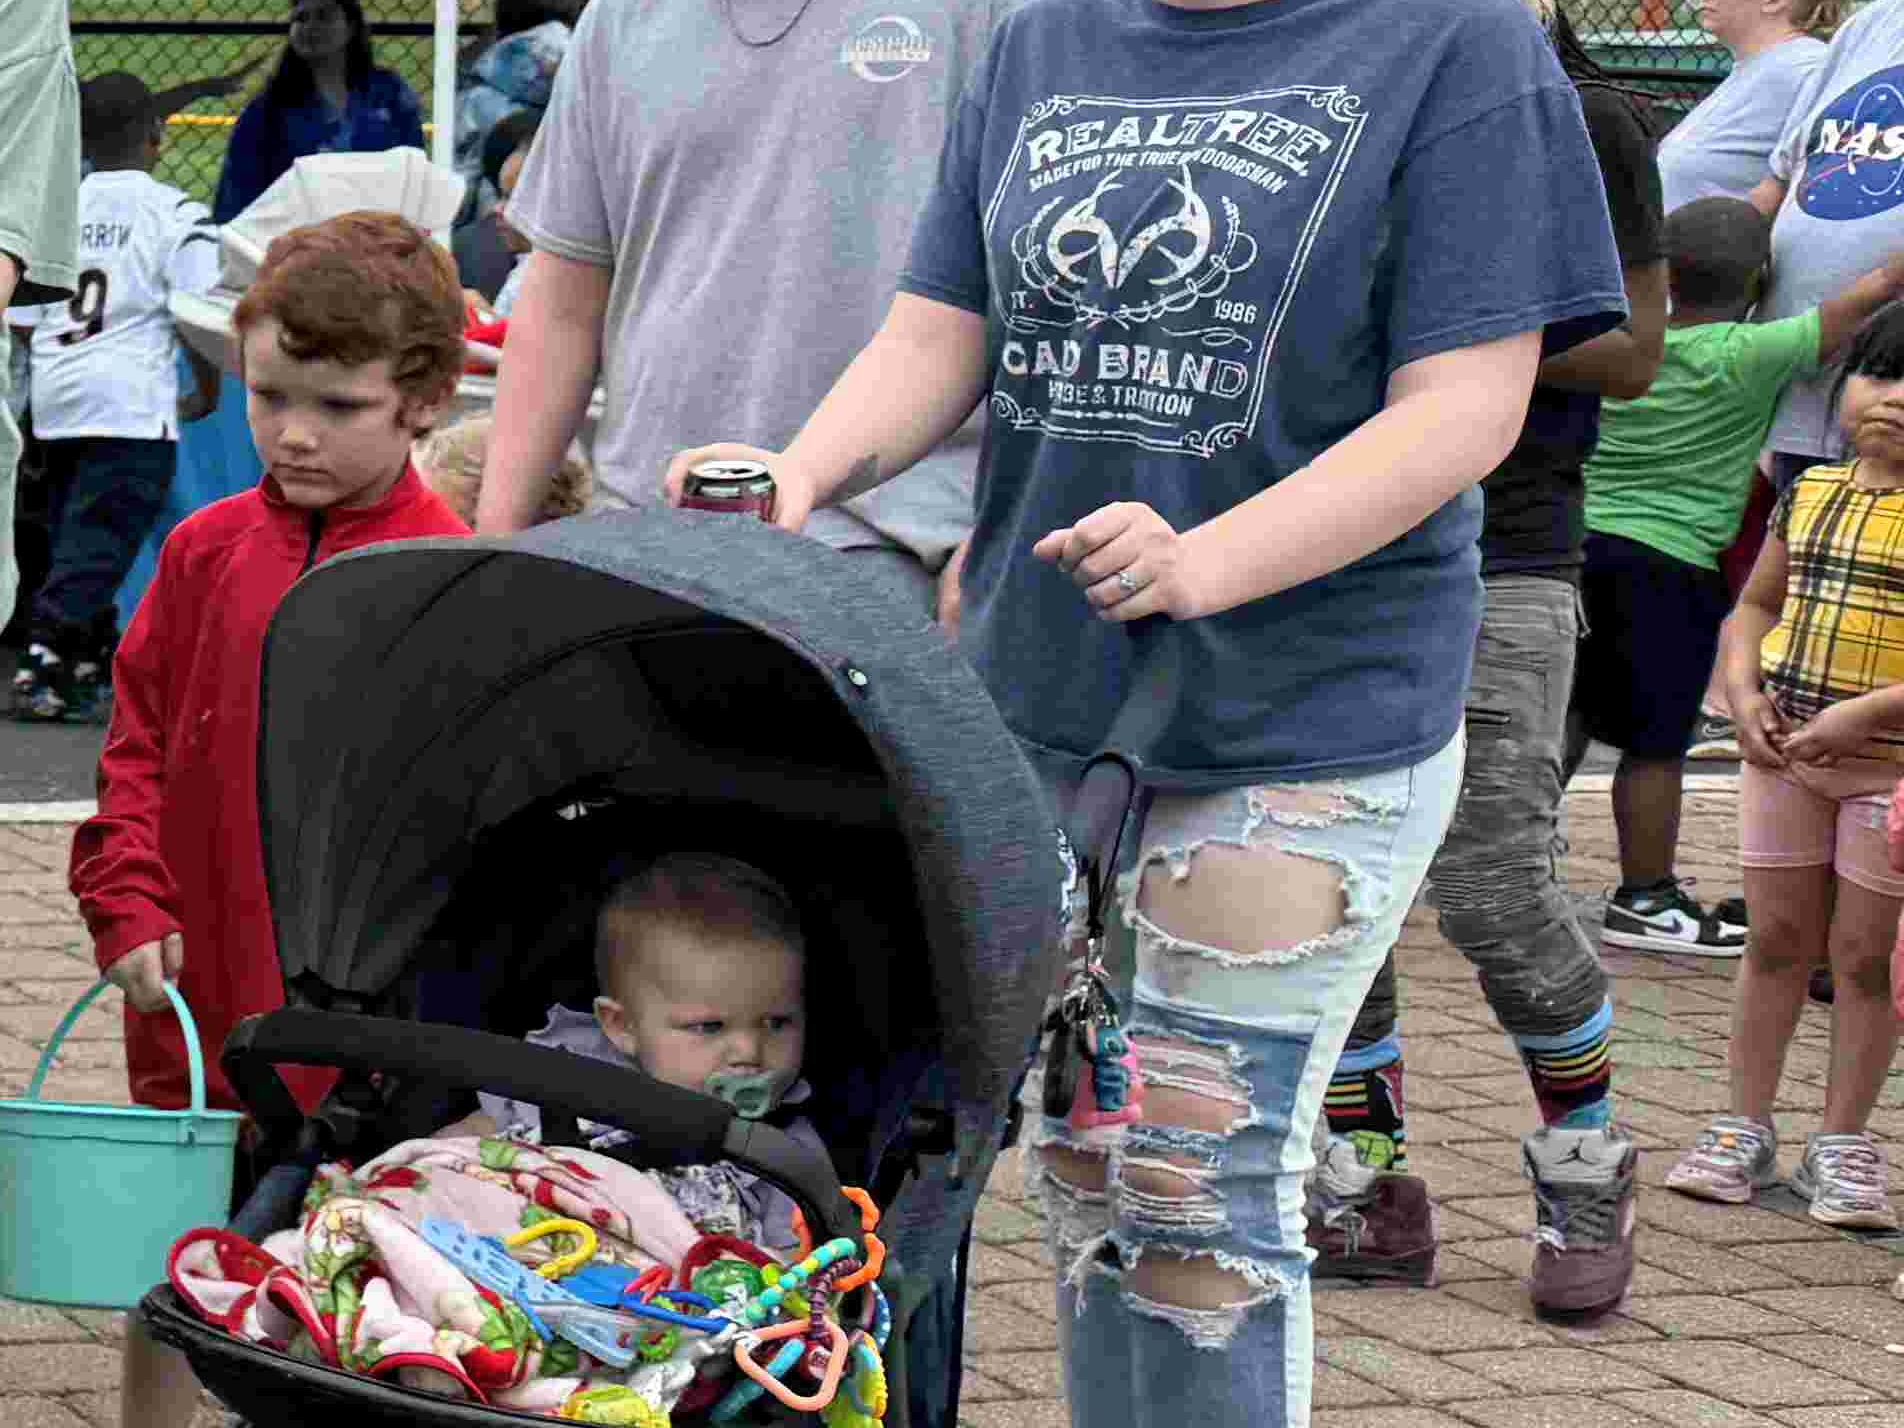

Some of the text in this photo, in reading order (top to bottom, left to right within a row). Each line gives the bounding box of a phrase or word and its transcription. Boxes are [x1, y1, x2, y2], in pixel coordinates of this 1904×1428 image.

[1026, 110, 1332, 176] REALTREE
[1215, 298, 1257, 324] 1986
[1097, 343, 1249, 398] BRAND
